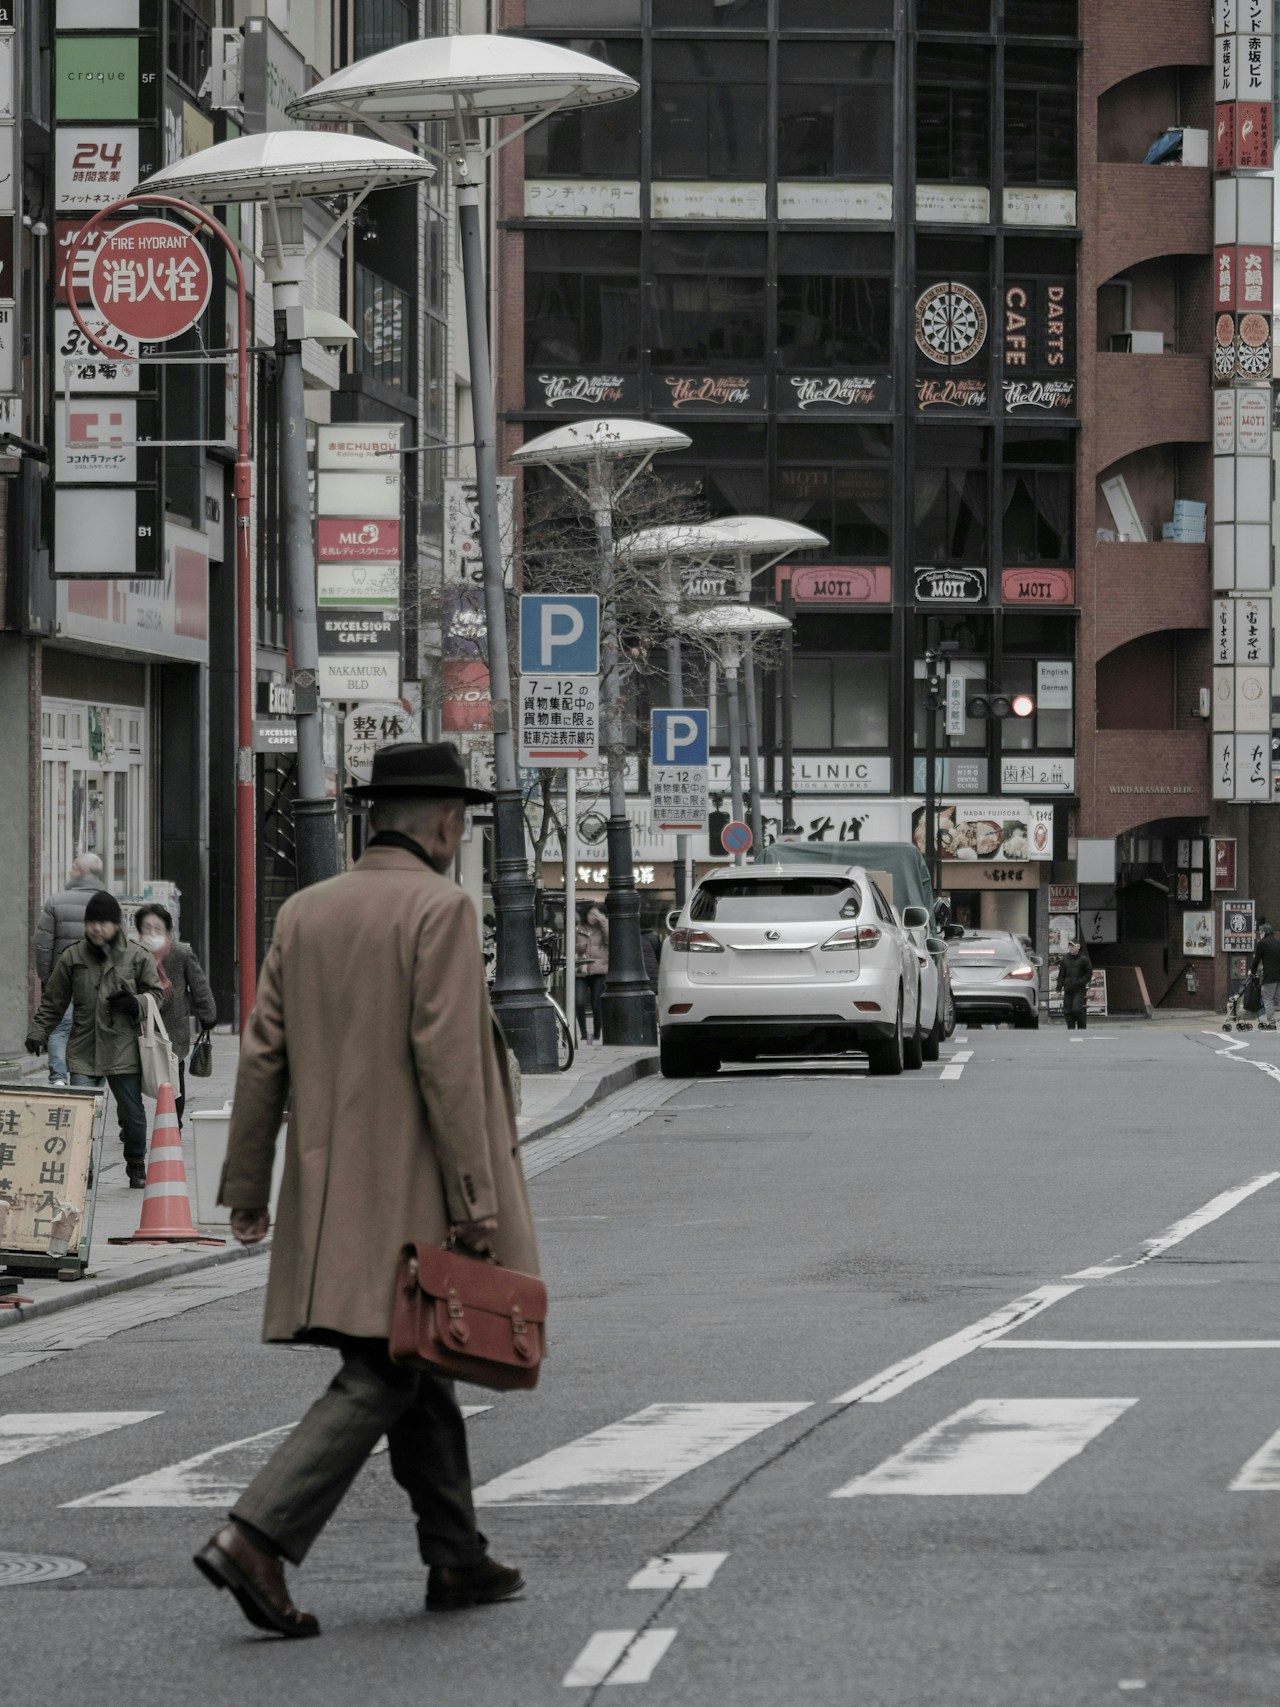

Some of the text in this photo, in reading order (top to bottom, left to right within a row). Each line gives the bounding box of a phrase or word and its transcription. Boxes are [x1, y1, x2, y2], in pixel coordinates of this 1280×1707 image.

[1222, 40, 1230, 90] 赤坂ビル
[1248, 38, 1262, 88] 赤坂ビル
[142, 73, 156, 83] 5F
[72, 143, 122, 169] 24
[1240, 156, 1252, 166] 8F
[140, 164, 152, 173] 4F
[72, 172, 120, 182] 時間営業
[111, 236, 188, 250] FIRE HYDRANT
[102, 256, 200, 304] 消火栓
[1219, 254, 1231, 302] 火鍋屋
[1244, 254, 1263, 302] 火鍋屋
[1006, 287, 1026, 365] CAFE
[1047, 286, 1064, 366] DARTS
[78, 364, 118, 380] 酒場
[571, 376, 606, 403] Day
[698, 378, 730, 404] Day
[824, 378, 858, 405] Day
[940, 380, 969, 407] Day
[1028, 382, 1058, 408] Day
[1242, 416, 1266, 426] MOTI
[388, 430, 399, 440] 6F
[66, 454, 126, 464] ココカラファイン
[386, 476, 399, 485] 5F
[782, 472, 828, 484] MOTI
[138, 528, 152, 537] B1
[339, 533, 368, 544] MLC
[688, 580, 726, 596] MOTI
[814, 580, 852, 596] MOTI
[931, 581, 966, 598] MOTI
[1018, 582, 1052, 598] MOTI
[325, 622, 391, 632] EXCELSIOR
[338, 632, 378, 643] CAFFÉ
[541, 604, 584, 665] P
[328, 666, 388, 676] NAKAMURA
[1041, 668, 1068, 677] English
[348, 680, 369, 690] BLD
[524, 697, 595, 711] 貨物集配中の
[951, 680, 961, 730] 歩車分離式
[524, 712, 594, 726] 貨物車に限る
[353, 716, 403, 740] 整体
[268, 736, 295, 744] CAFFÉ
[524, 732, 594, 746] 駐車方法表示線内
[667, 716, 698, 761] P
[1004, 765, 1035, 782] 歯科
[654, 784, 706, 794] 貨物集配中の
[1109, 786, 1194, 794] WIND AKASAKA BLDG
[654, 795, 706, 806] 貨物車に限る
[654, 809, 706, 819] 駐車方法表示線内
[1050, 887, 1078, 897] MOTI
